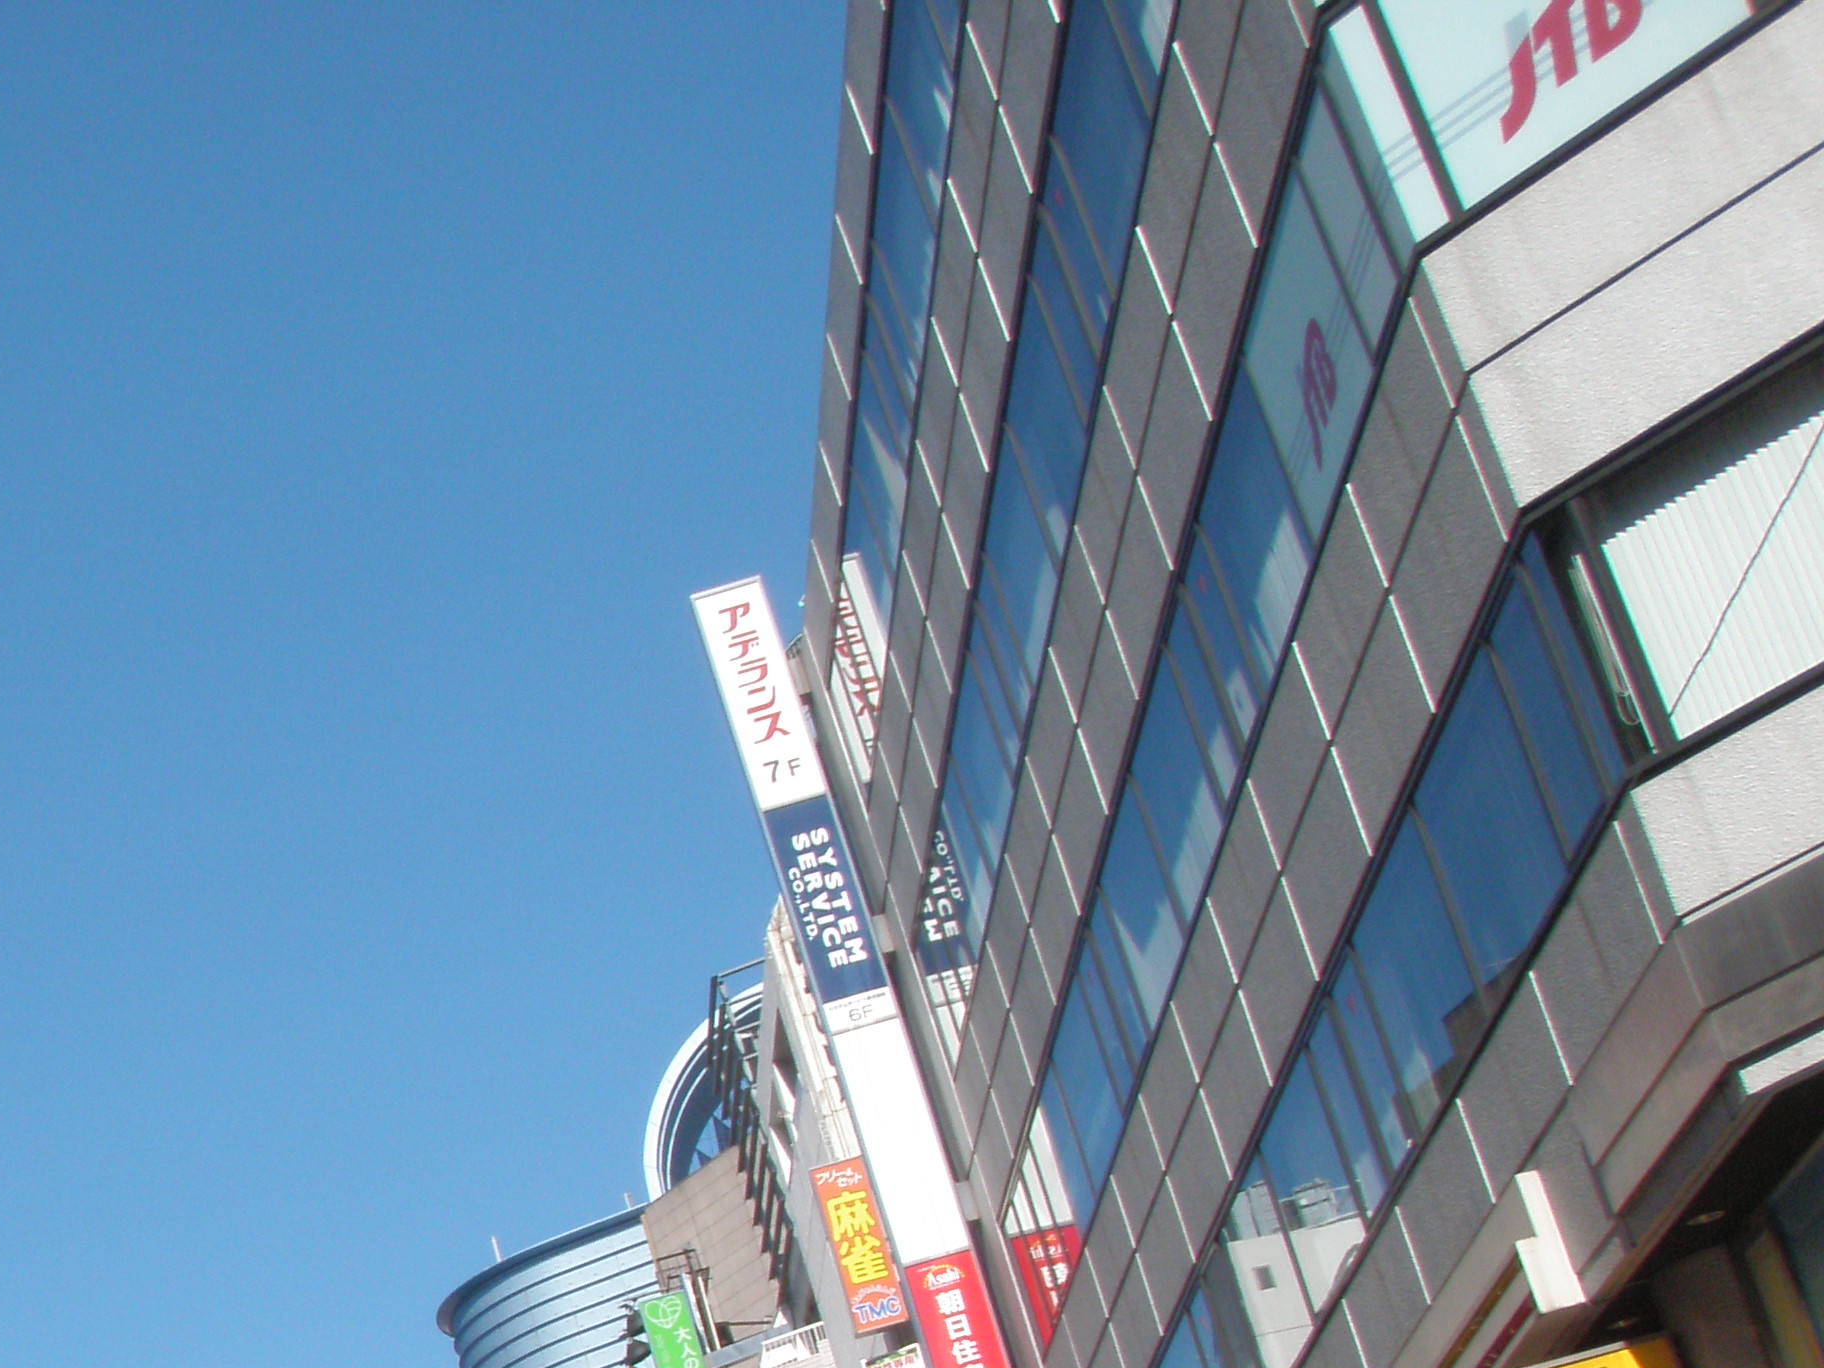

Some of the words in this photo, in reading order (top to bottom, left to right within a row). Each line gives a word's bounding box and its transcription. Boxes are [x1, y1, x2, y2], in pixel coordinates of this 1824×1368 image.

[718, 601, 790, 745] アデランス
[762, 757, 801, 783] 7F
[791, 833, 848, 968] SERVICE
[811, 827, 868, 963] SYSTEM
[849, 1004, 875, 1022] 6F
[826, 1190, 889, 1285] 麻雀
[926, 1267, 962, 1290] Asahi
[852, 1296, 901, 1324] TMC
